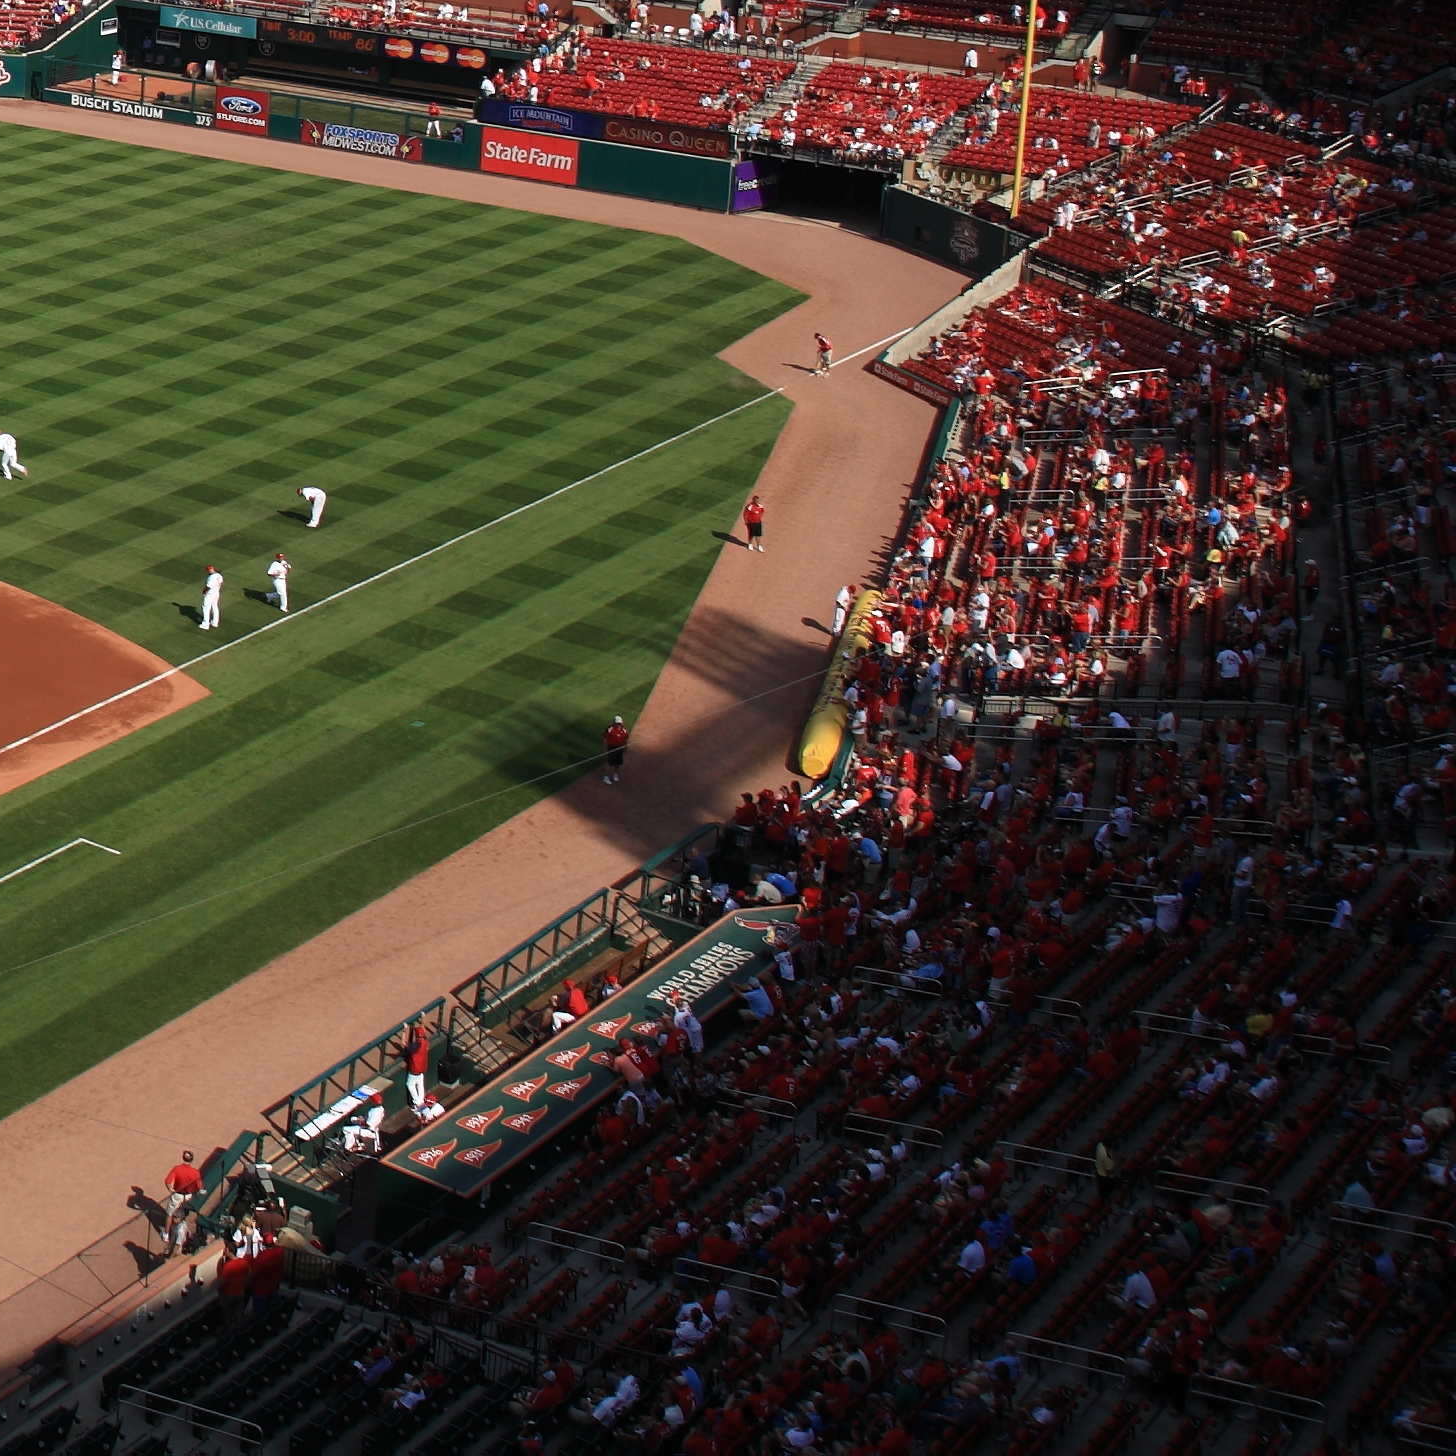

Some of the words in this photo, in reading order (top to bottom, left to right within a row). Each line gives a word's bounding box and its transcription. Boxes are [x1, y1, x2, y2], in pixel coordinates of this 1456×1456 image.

[205, 19, 242, 34] Cellular
[287, 29, 316, 43] 3:00
[71, 93, 110, 112] BUSCH
[112, 100, 163, 120] STADIUM
[228, 96, 255, 114] Ford
[525, 109, 570, 127] MOUNTAIN
[325, 123, 350, 139] FOX
[349, 127, 399, 146] SPORTS
[605, 121, 664, 144] CASINO
[668, 130, 725, 154] QUEEN
[322, 135, 398, 157] MIDWEST.COM
[485, 141, 528, 164] State
[528, 149, 573, 172] Farm
[941, 168, 996, 187] CABANA
[646, 969, 696, 1001] WORLD
[690, 941, 734, 971] SERIES
